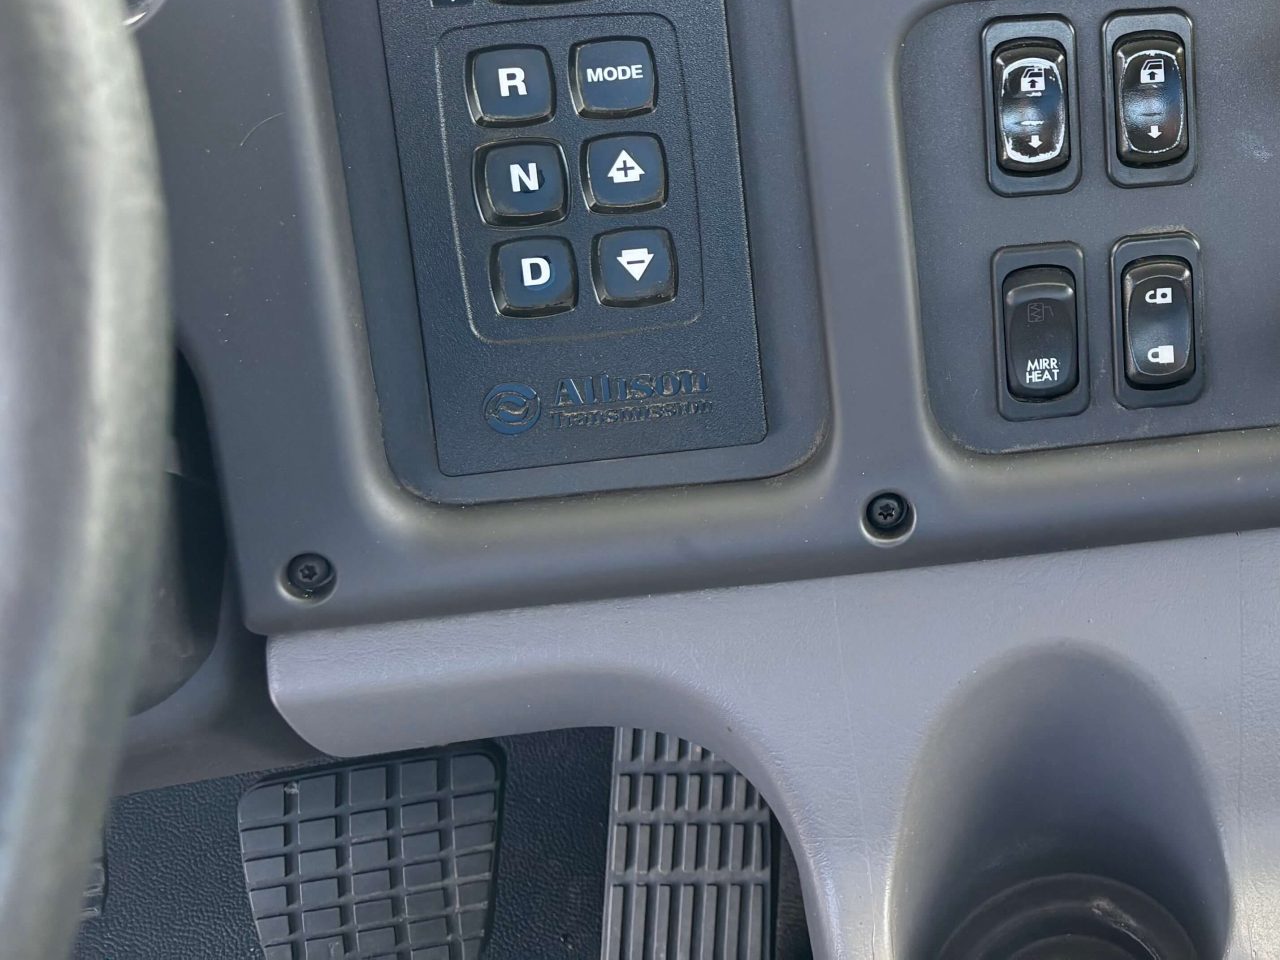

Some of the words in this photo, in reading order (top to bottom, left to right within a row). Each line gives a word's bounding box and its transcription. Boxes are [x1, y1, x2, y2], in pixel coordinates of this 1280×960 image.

[498, 67, 528, 97] R
[586, 64, 643, 83] MODE
[509, 162, 540, 193] N
[521, 256, 551, 287] D
[1025, 369, 1060, 384] HEAT
[1026, 357, 1059, 372] MIRR
[553, 369, 712, 406] Allison
